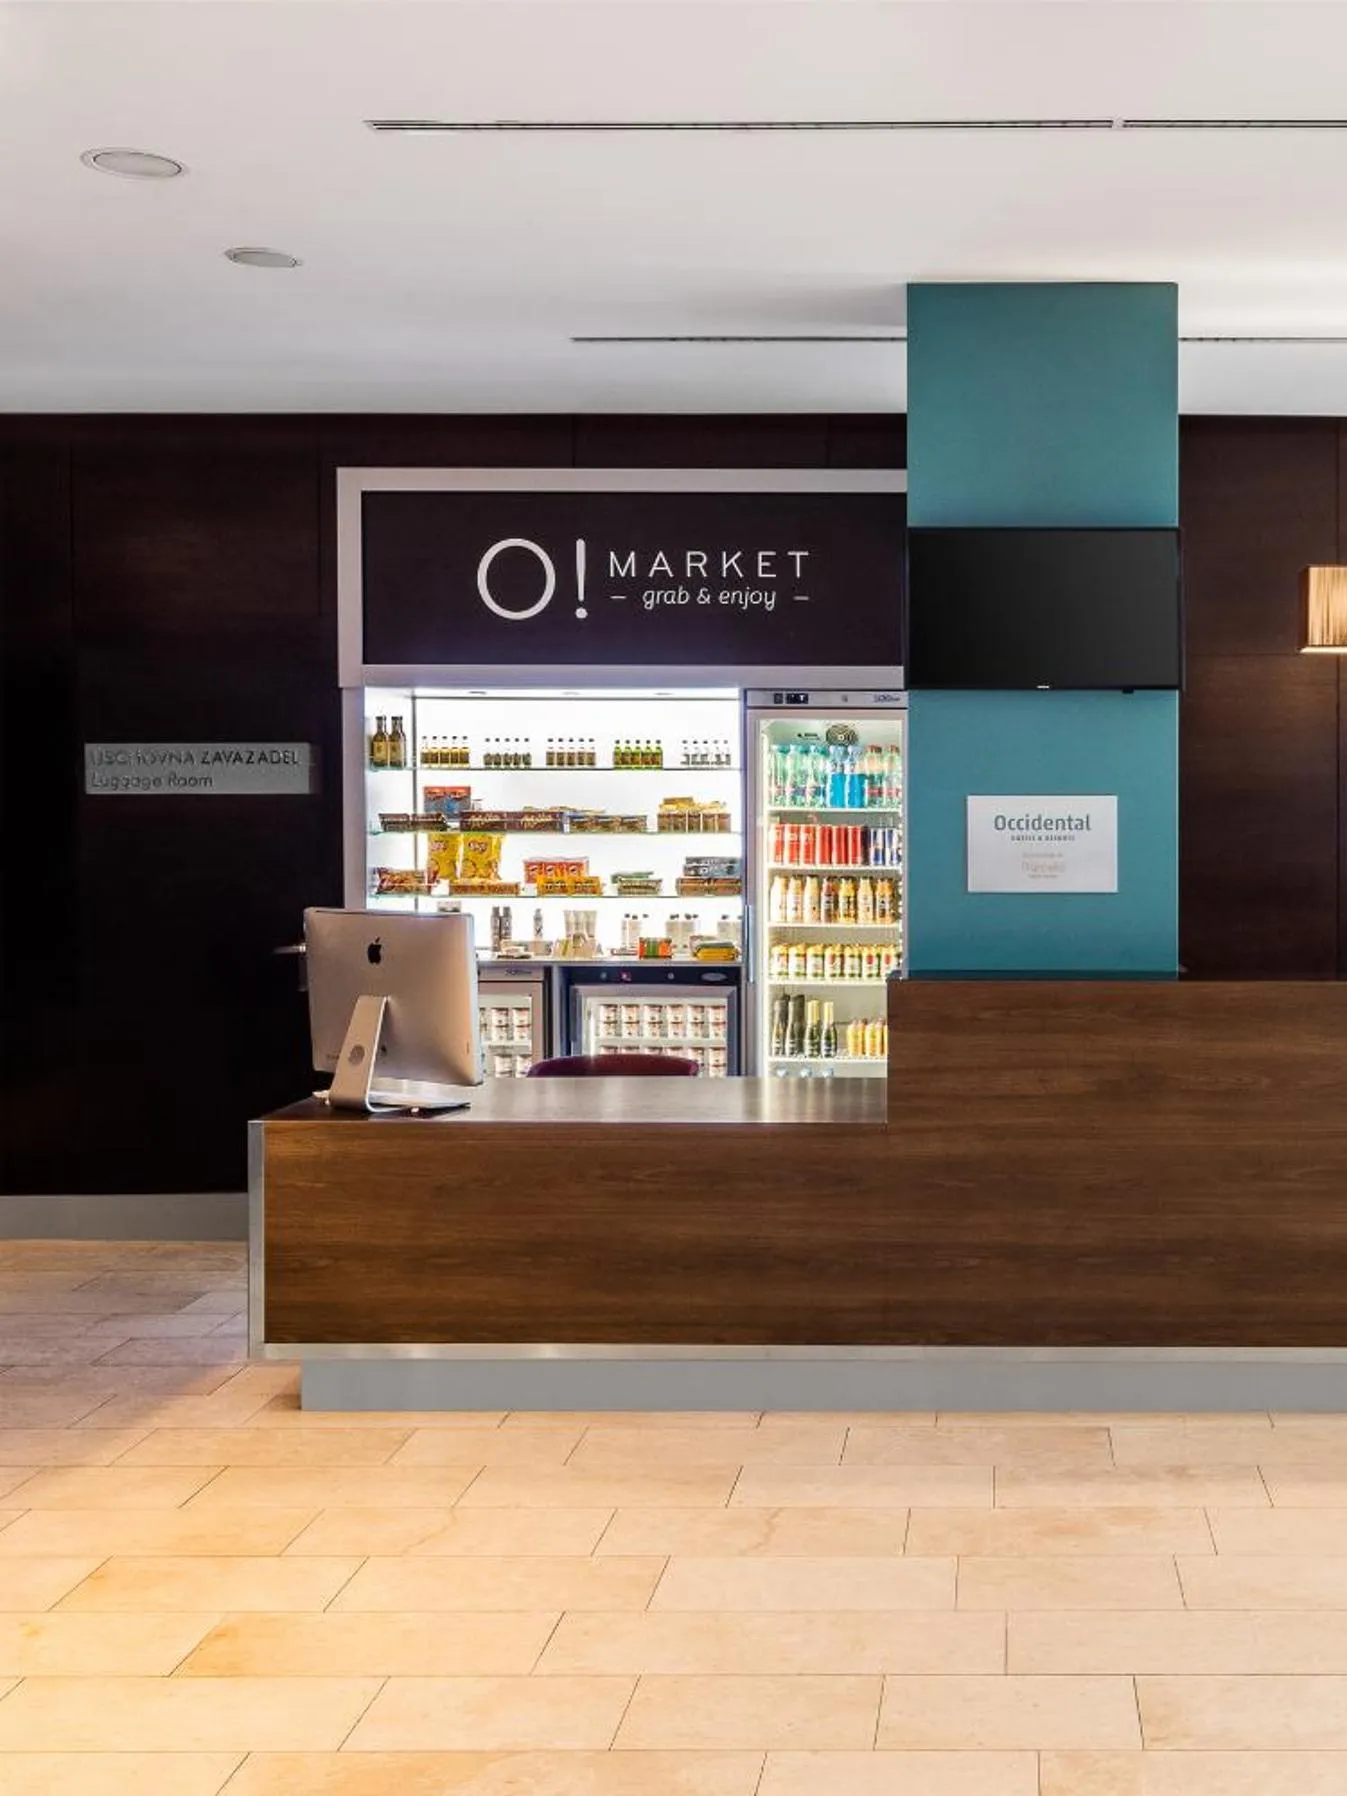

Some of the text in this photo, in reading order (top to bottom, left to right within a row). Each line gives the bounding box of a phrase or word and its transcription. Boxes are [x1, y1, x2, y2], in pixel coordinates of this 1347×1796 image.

[608, 551, 809, 578] MARKET
[477, 538, 588, 620] O!
[642, 586, 776, 611] grab & enjoy
[91, 771, 213, 790] Luggage Room
[994, 813, 1091, 831] Occidental
